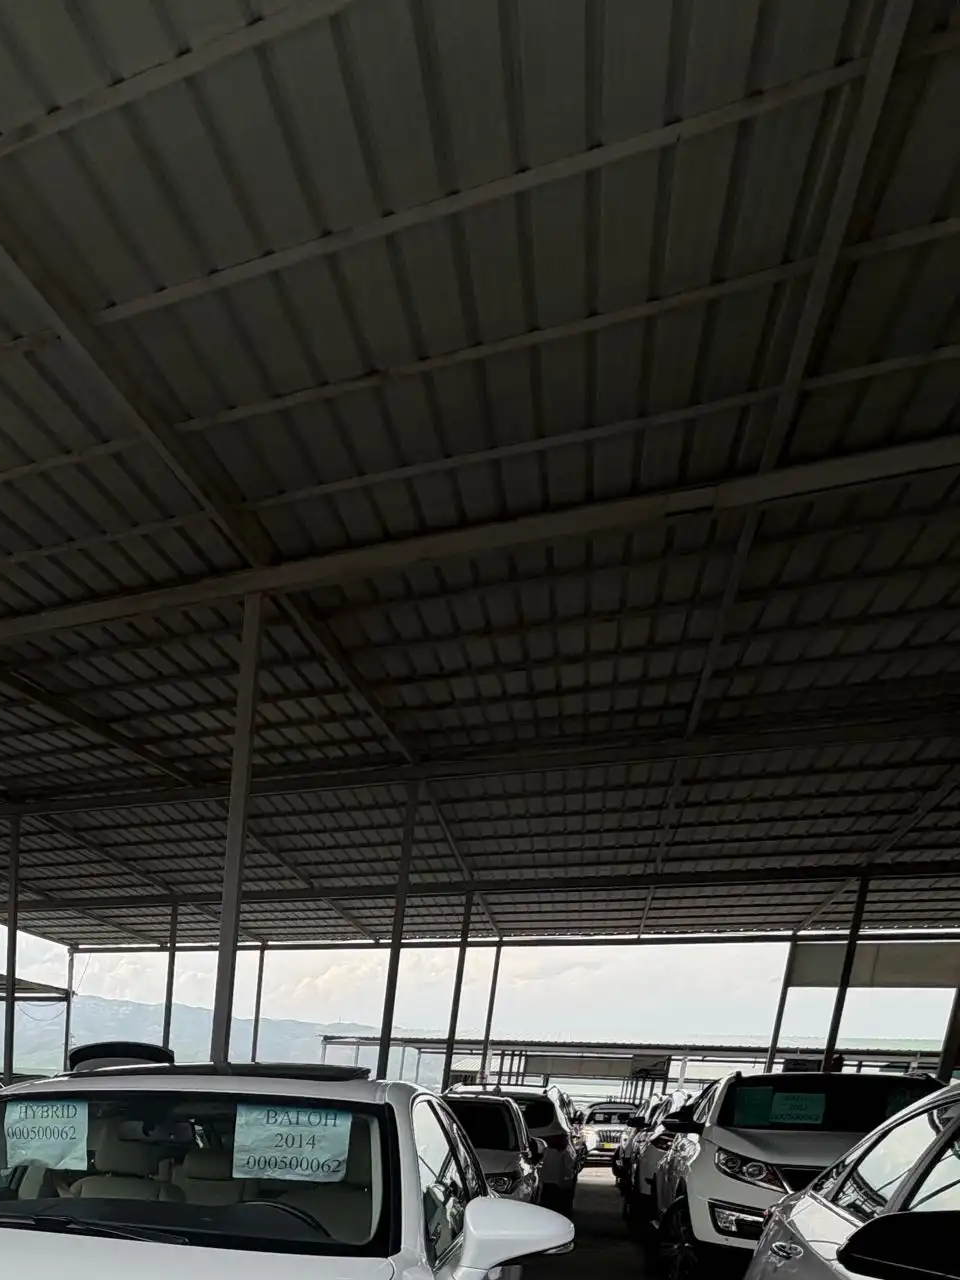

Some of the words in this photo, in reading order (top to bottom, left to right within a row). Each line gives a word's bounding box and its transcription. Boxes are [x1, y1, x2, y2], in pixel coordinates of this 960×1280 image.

[19, 1104, 78, 1119] HYBRID
[266, 1109, 338, 1127] ВАГОН
[7, 1125, 77, 1140] 000500062
[274, 1133, 317, 1150] 2014
[246, 1155, 342, 1173] 000500062
